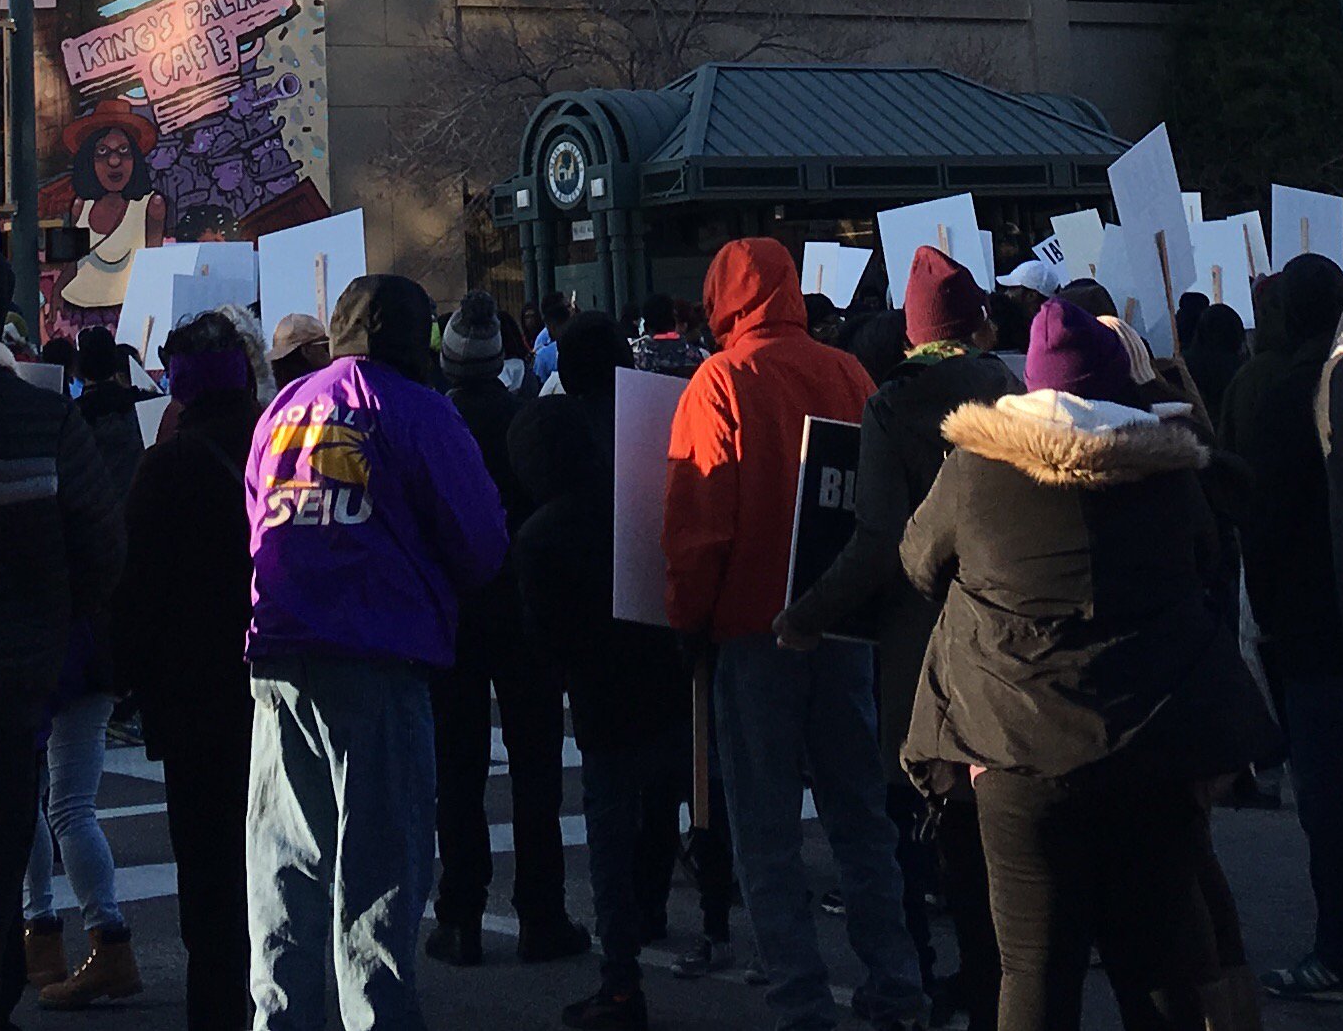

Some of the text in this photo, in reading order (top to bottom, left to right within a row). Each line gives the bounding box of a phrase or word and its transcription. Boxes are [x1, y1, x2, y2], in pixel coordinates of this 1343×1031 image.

[77, 13, 175, 72] KING'S
[149, 26, 231, 87] CAFE
[261, 488, 373, 528] SEIU
